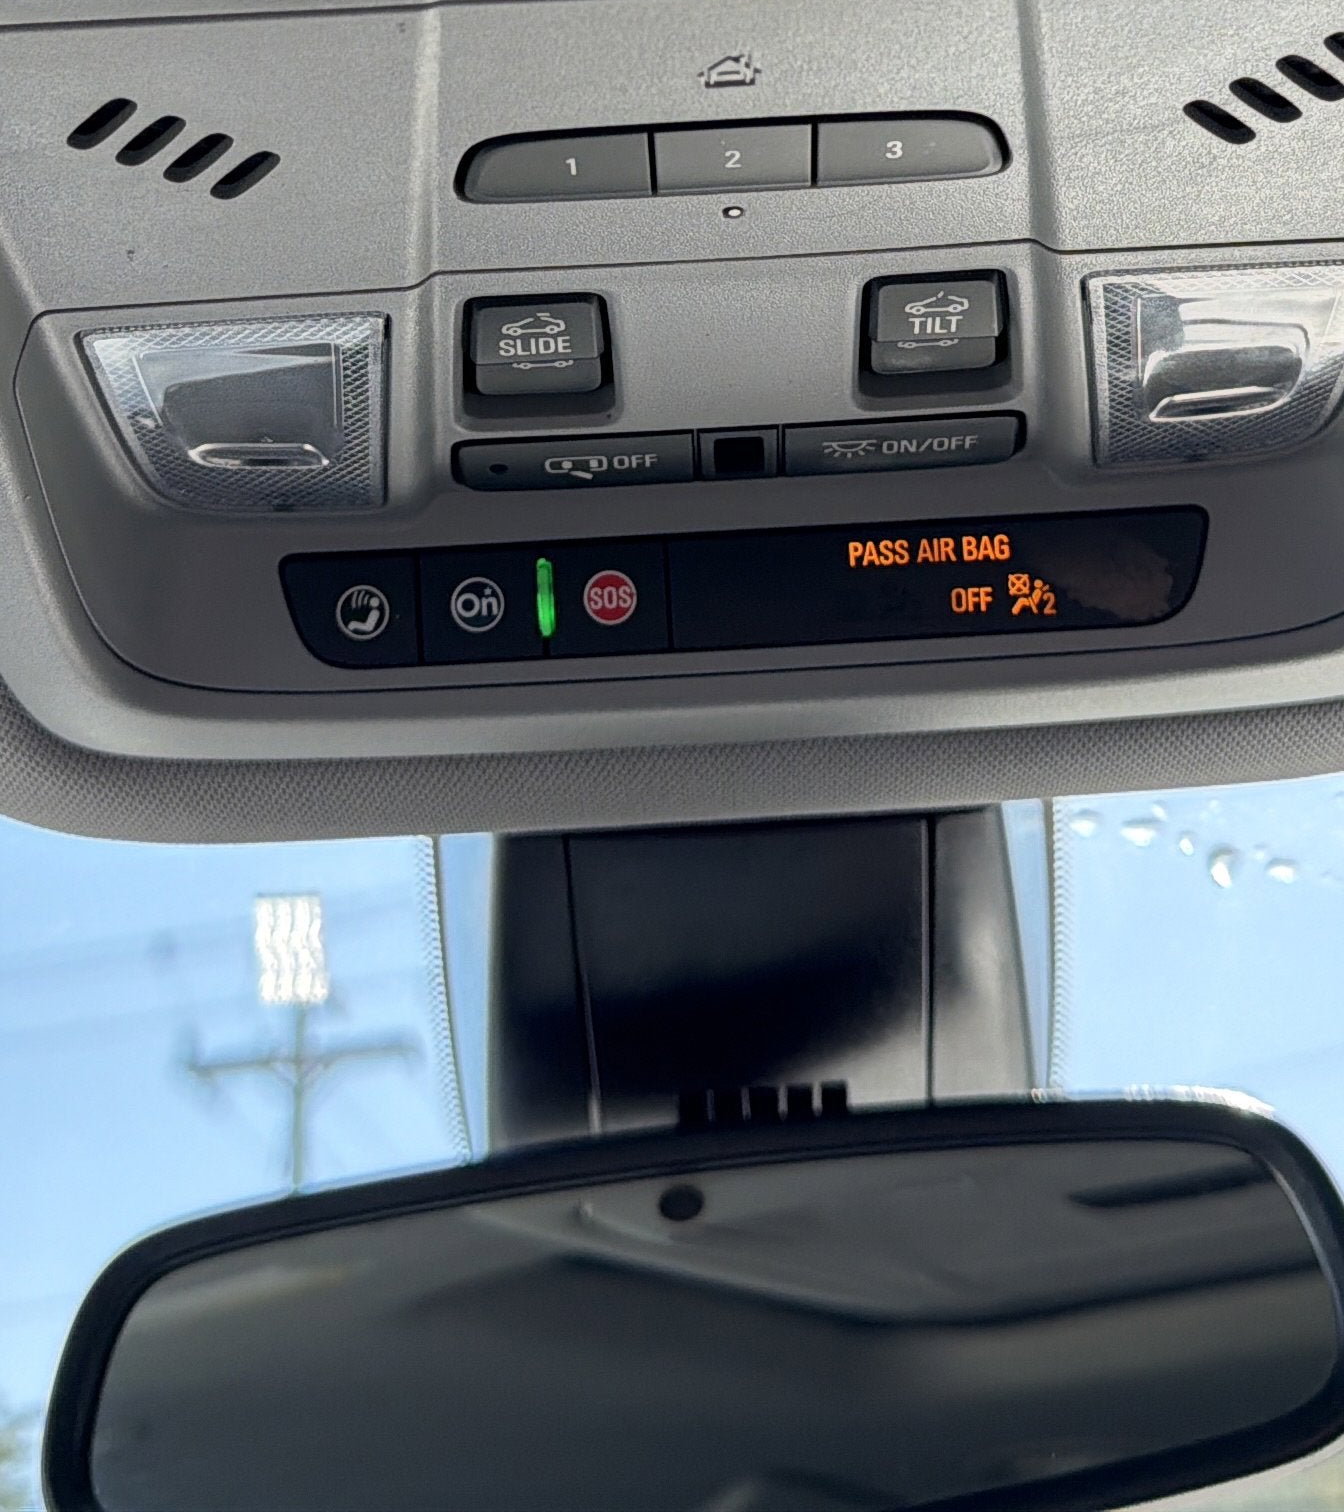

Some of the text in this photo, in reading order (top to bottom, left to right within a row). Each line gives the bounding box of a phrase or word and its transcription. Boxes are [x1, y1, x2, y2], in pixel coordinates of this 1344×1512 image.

[724, 150, 742, 169] 2
[885, 140, 904, 159] 3
[565, 156, 579, 176] 1
[907, 315, 963, 336] TILT
[498, 335, 572, 357] SLIDE
[881, 434, 978, 456] ON/OFF
[613, 452, 659, 472] OFF
[848, 534, 1011, 568] PASS AIR BAG
[456, 588, 499, 618] On
[589, 585, 633, 610] SOS
[950, 586, 993, 614] OFF
